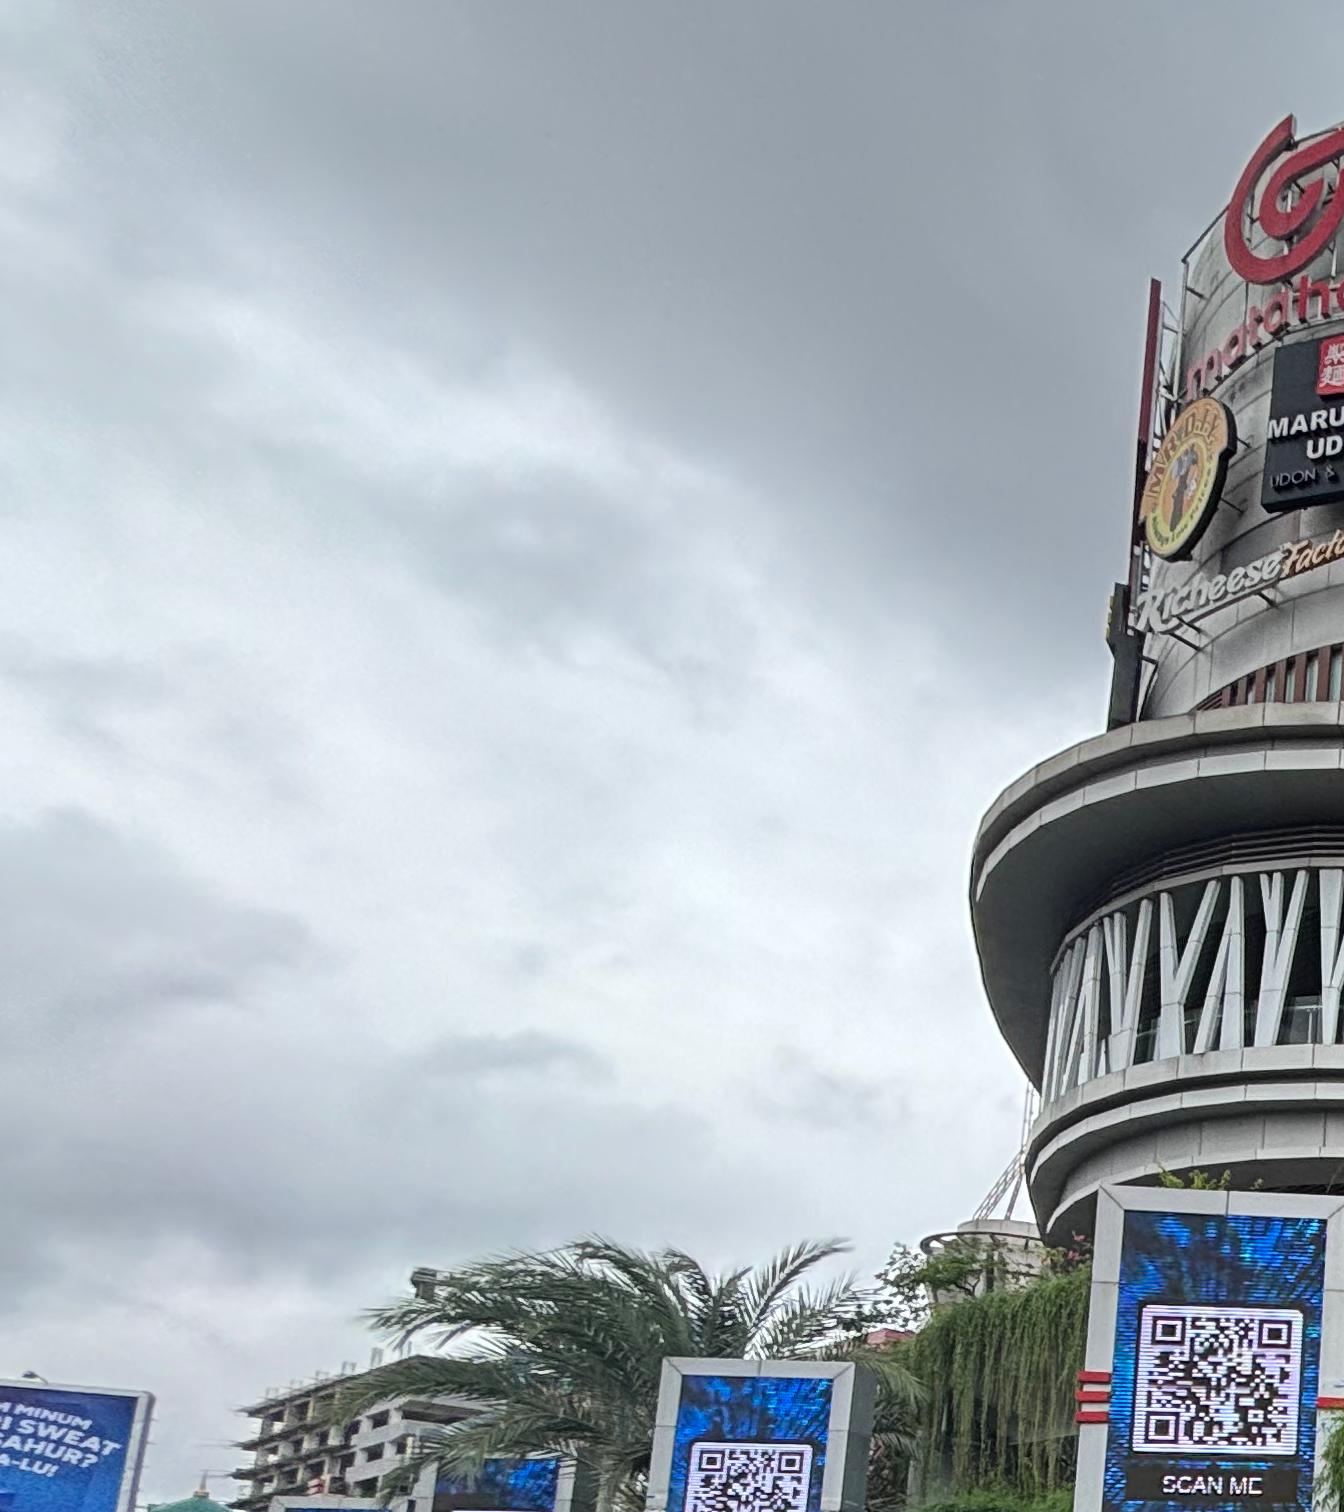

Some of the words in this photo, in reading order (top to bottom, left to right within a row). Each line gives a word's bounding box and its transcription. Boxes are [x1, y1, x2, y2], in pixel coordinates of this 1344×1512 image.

[1270, 467, 1316, 488] UDON
[1325, 464, 1336, 478] &
[1135, 550, 1286, 634] Richeese
[13, 1402, 94, 1431] MINUM
[16, 1418, 122, 1456] SWEAT
[1162, 1475, 1223, 1495] SCAN
[1229, 1476, 1263, 1495] ME
